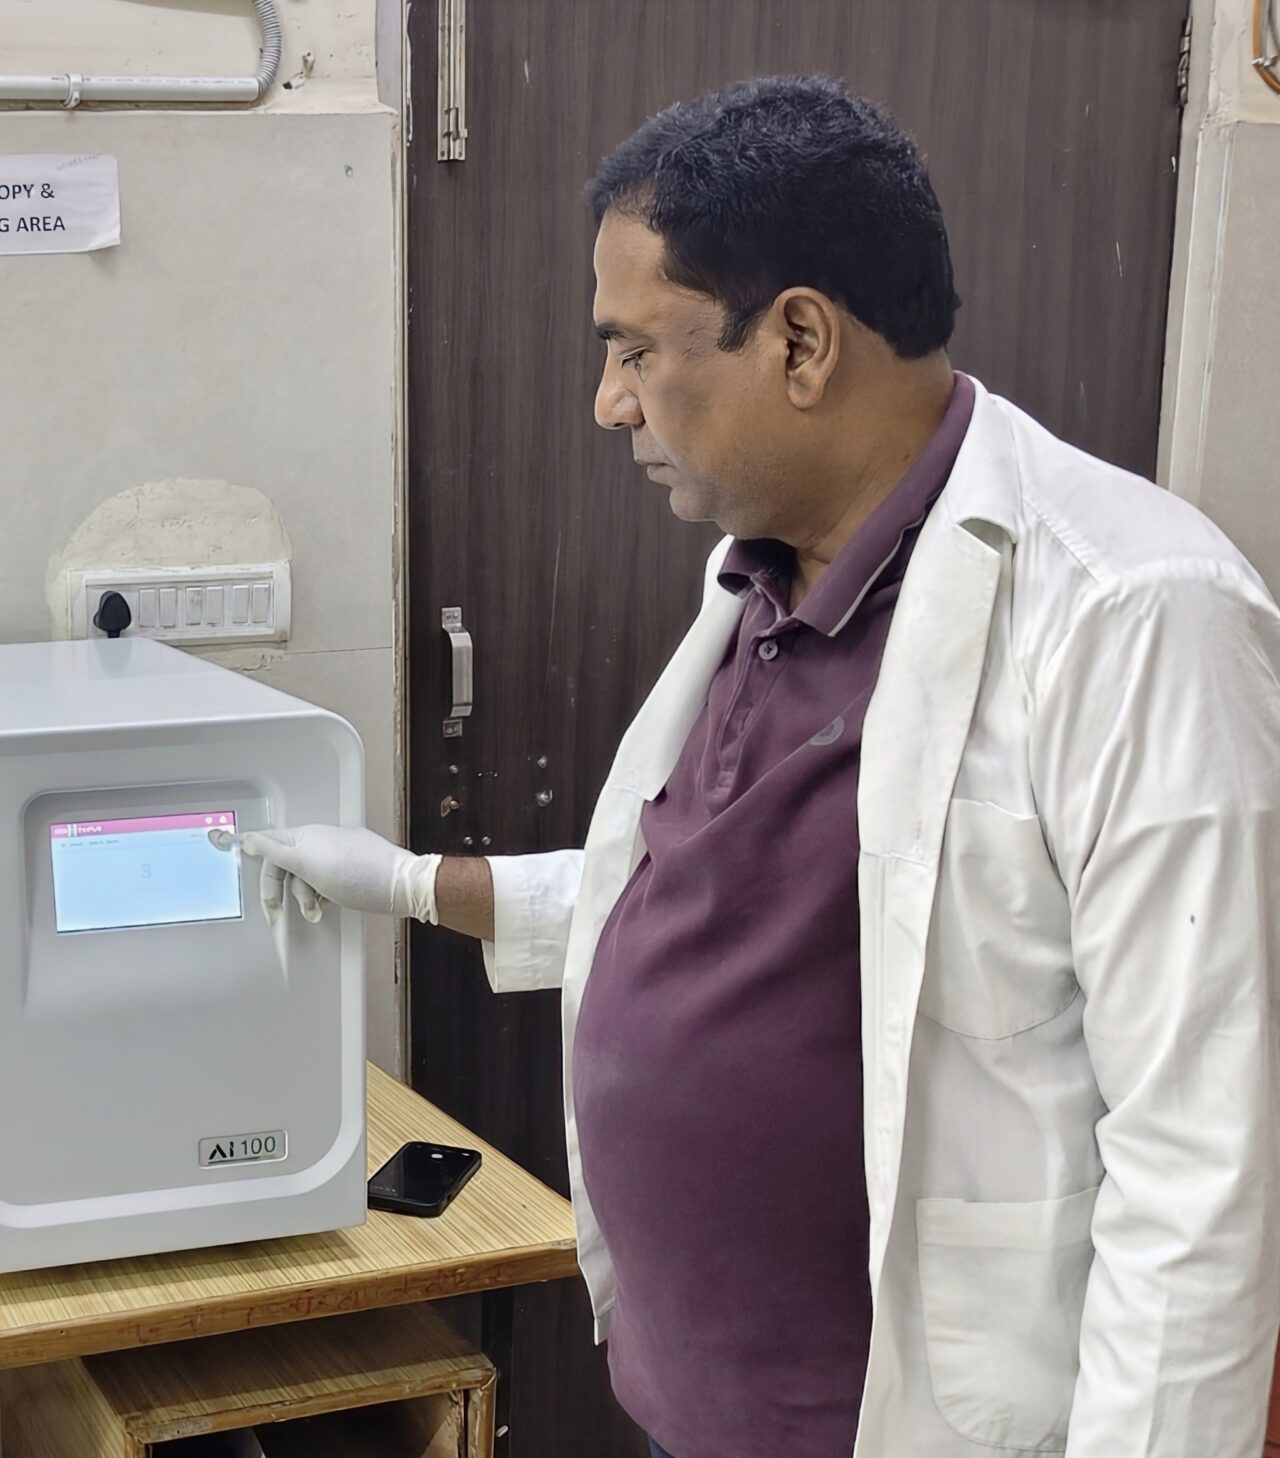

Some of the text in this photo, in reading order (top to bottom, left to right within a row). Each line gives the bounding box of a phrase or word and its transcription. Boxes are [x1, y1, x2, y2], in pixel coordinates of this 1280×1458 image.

[40, 183, 55, 199] &
[15, 215, 66, 232] AREA
[241, 1136, 276, 1155] 100
